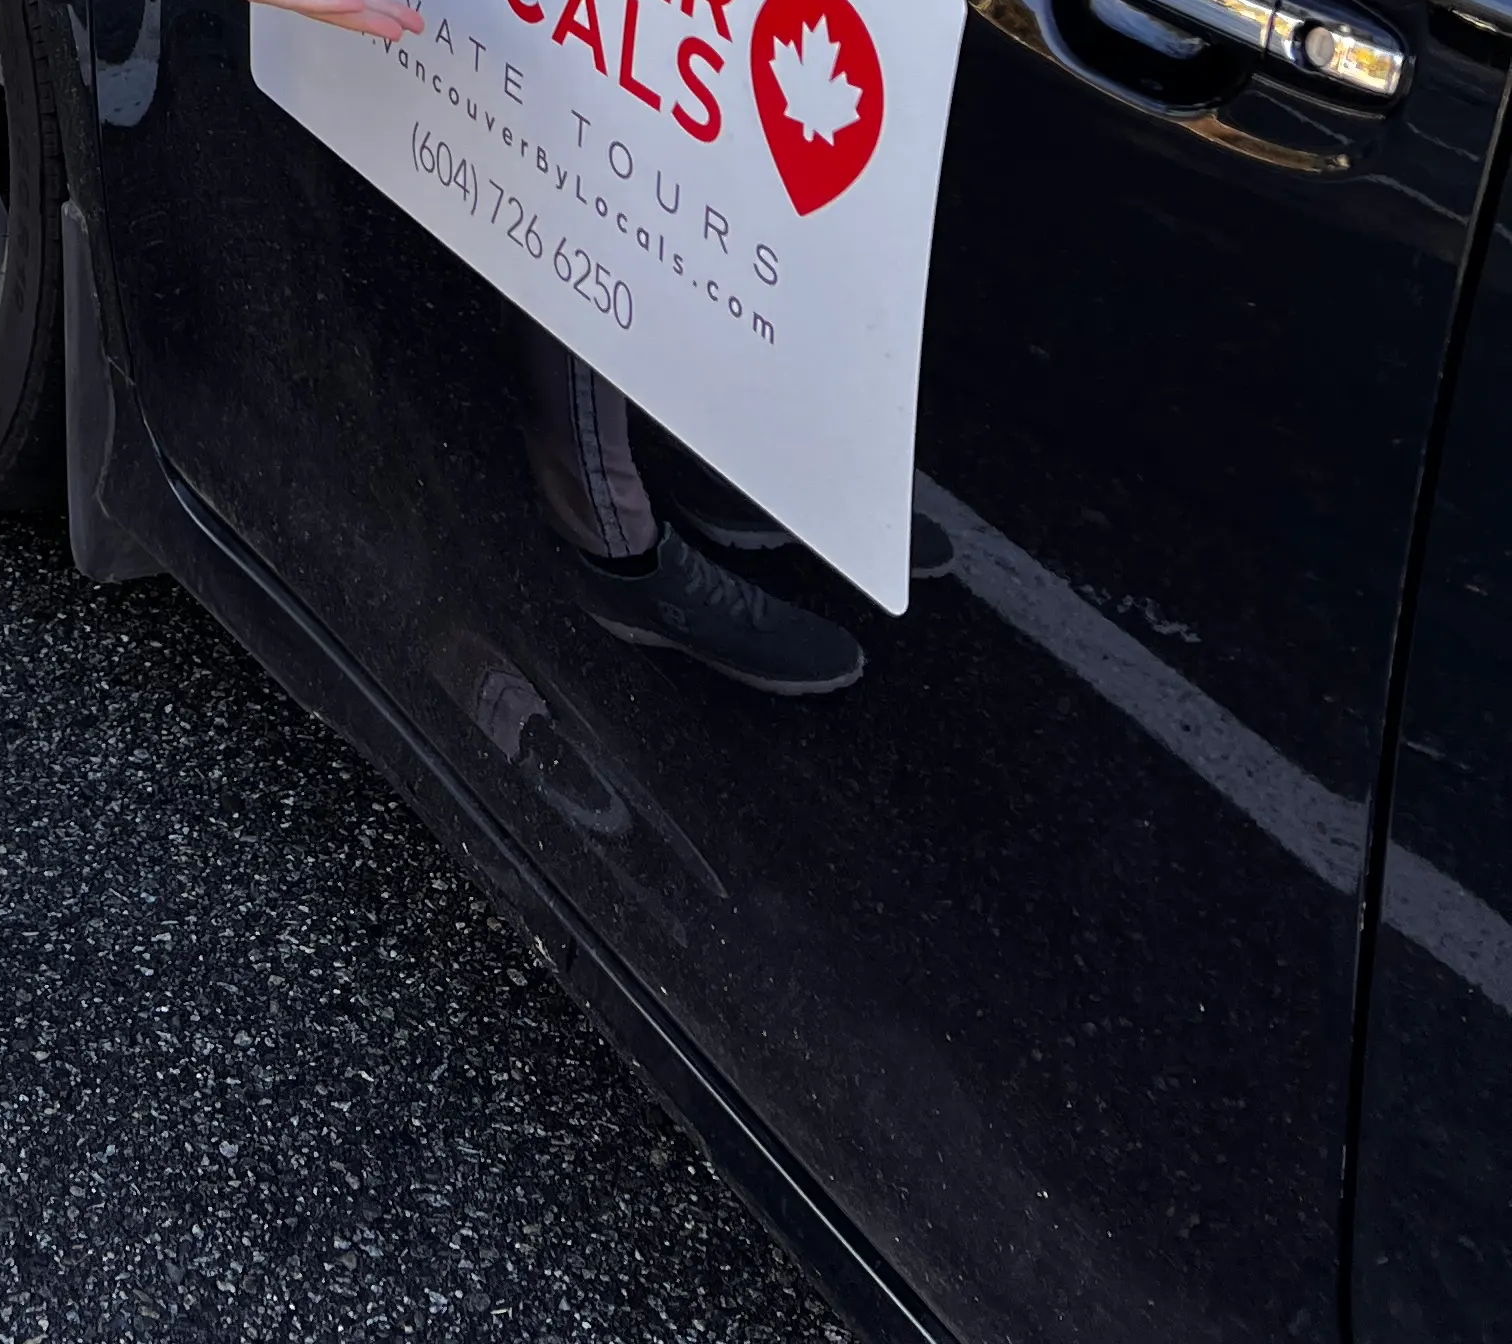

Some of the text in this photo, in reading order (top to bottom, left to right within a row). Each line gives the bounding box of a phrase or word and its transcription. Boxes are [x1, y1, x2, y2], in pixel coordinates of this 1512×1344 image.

[411, 120, 634, 331] (604) 726 6250
[570, 109, 779, 288] TOURS
